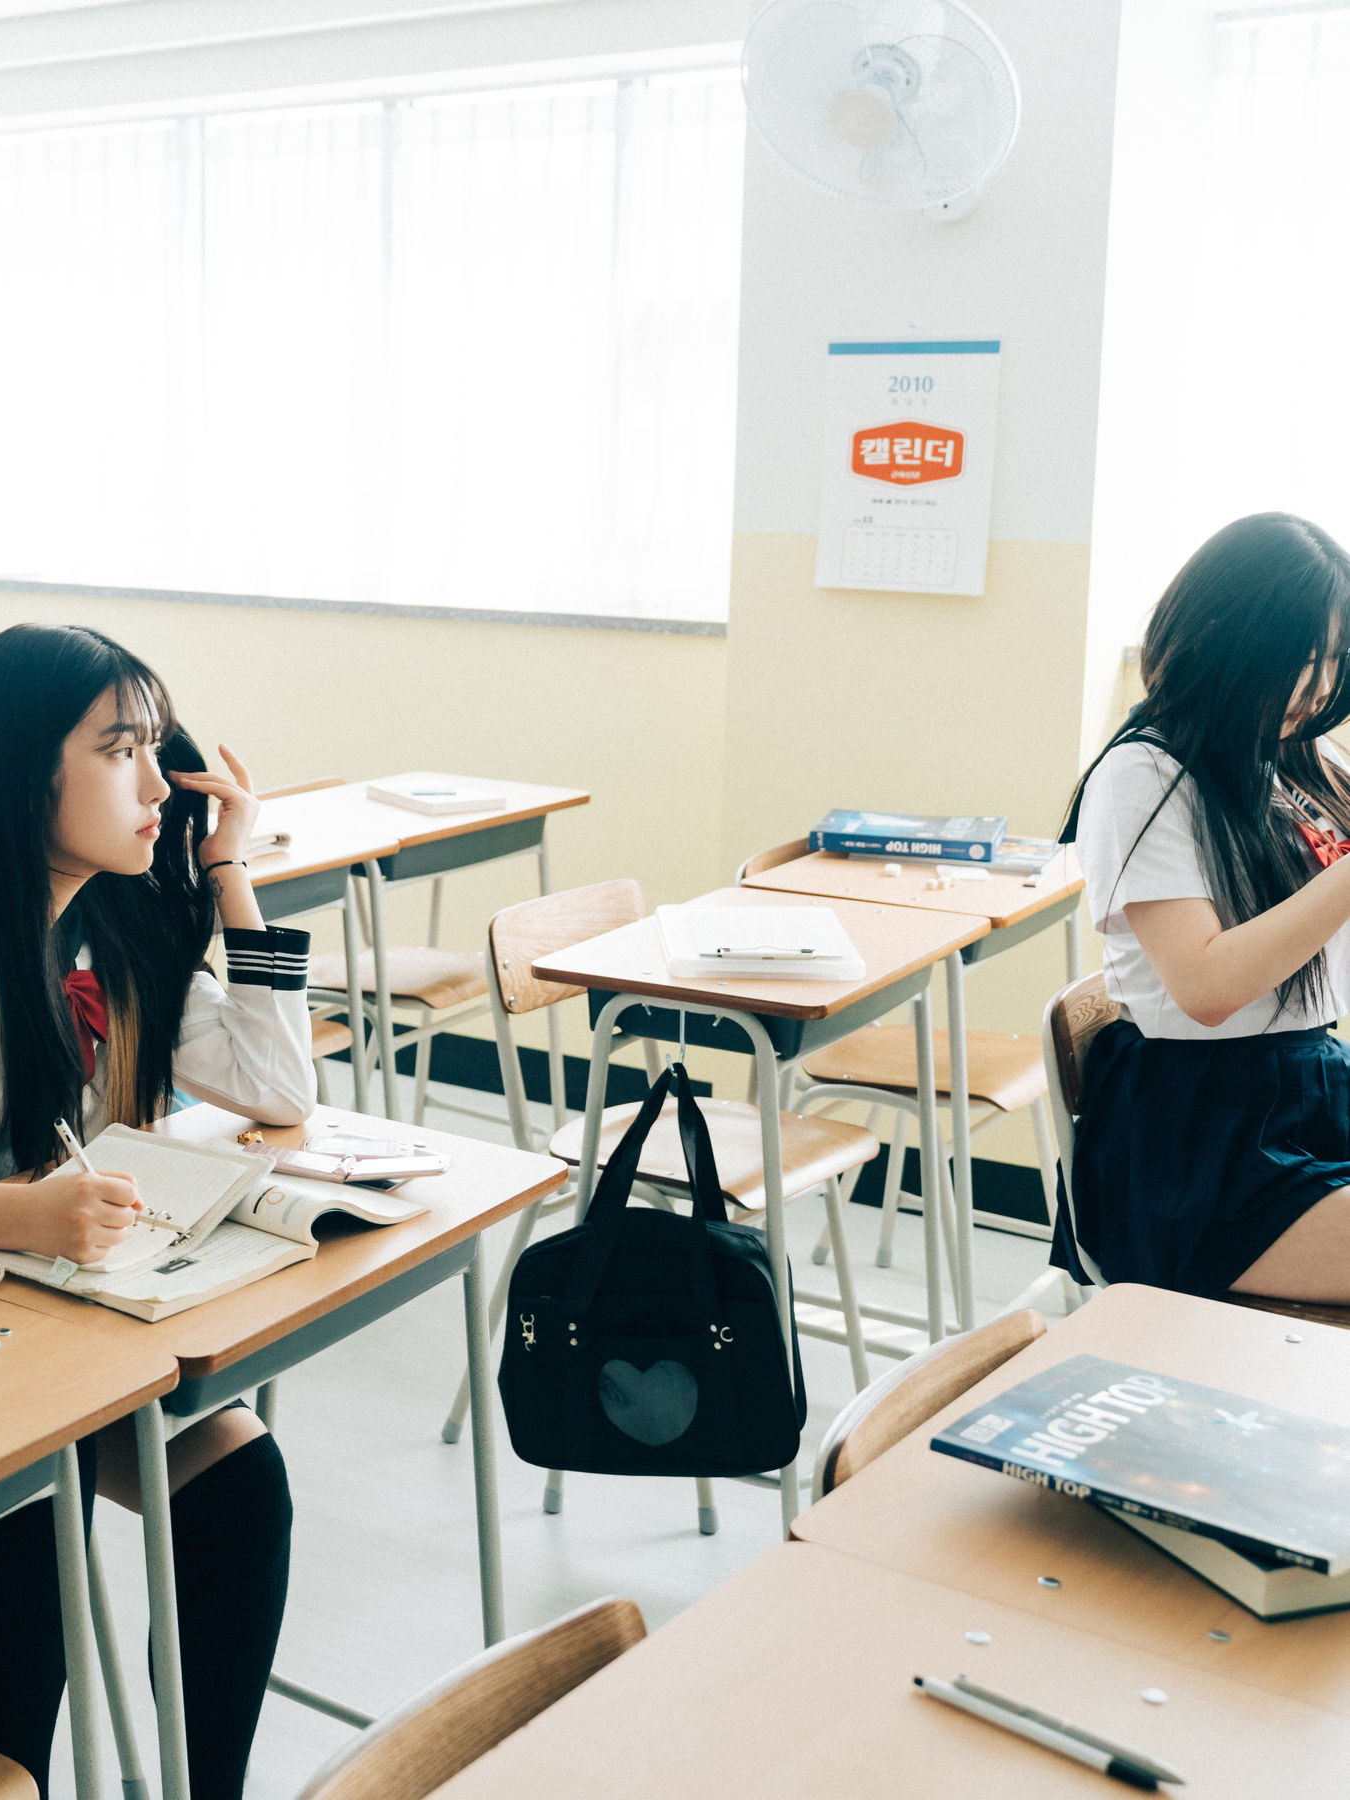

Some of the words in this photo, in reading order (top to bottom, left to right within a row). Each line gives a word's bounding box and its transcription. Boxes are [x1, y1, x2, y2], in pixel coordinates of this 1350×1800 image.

[888, 375, 934, 393] 2010
[860, 437, 955, 467] 캘린더
[885, 840, 910, 854] TOP
[911, 842, 942, 856] HIGH
[1002, 1462, 1049, 1489] HIGH
[1053, 1477, 1091, 1499] TOP
